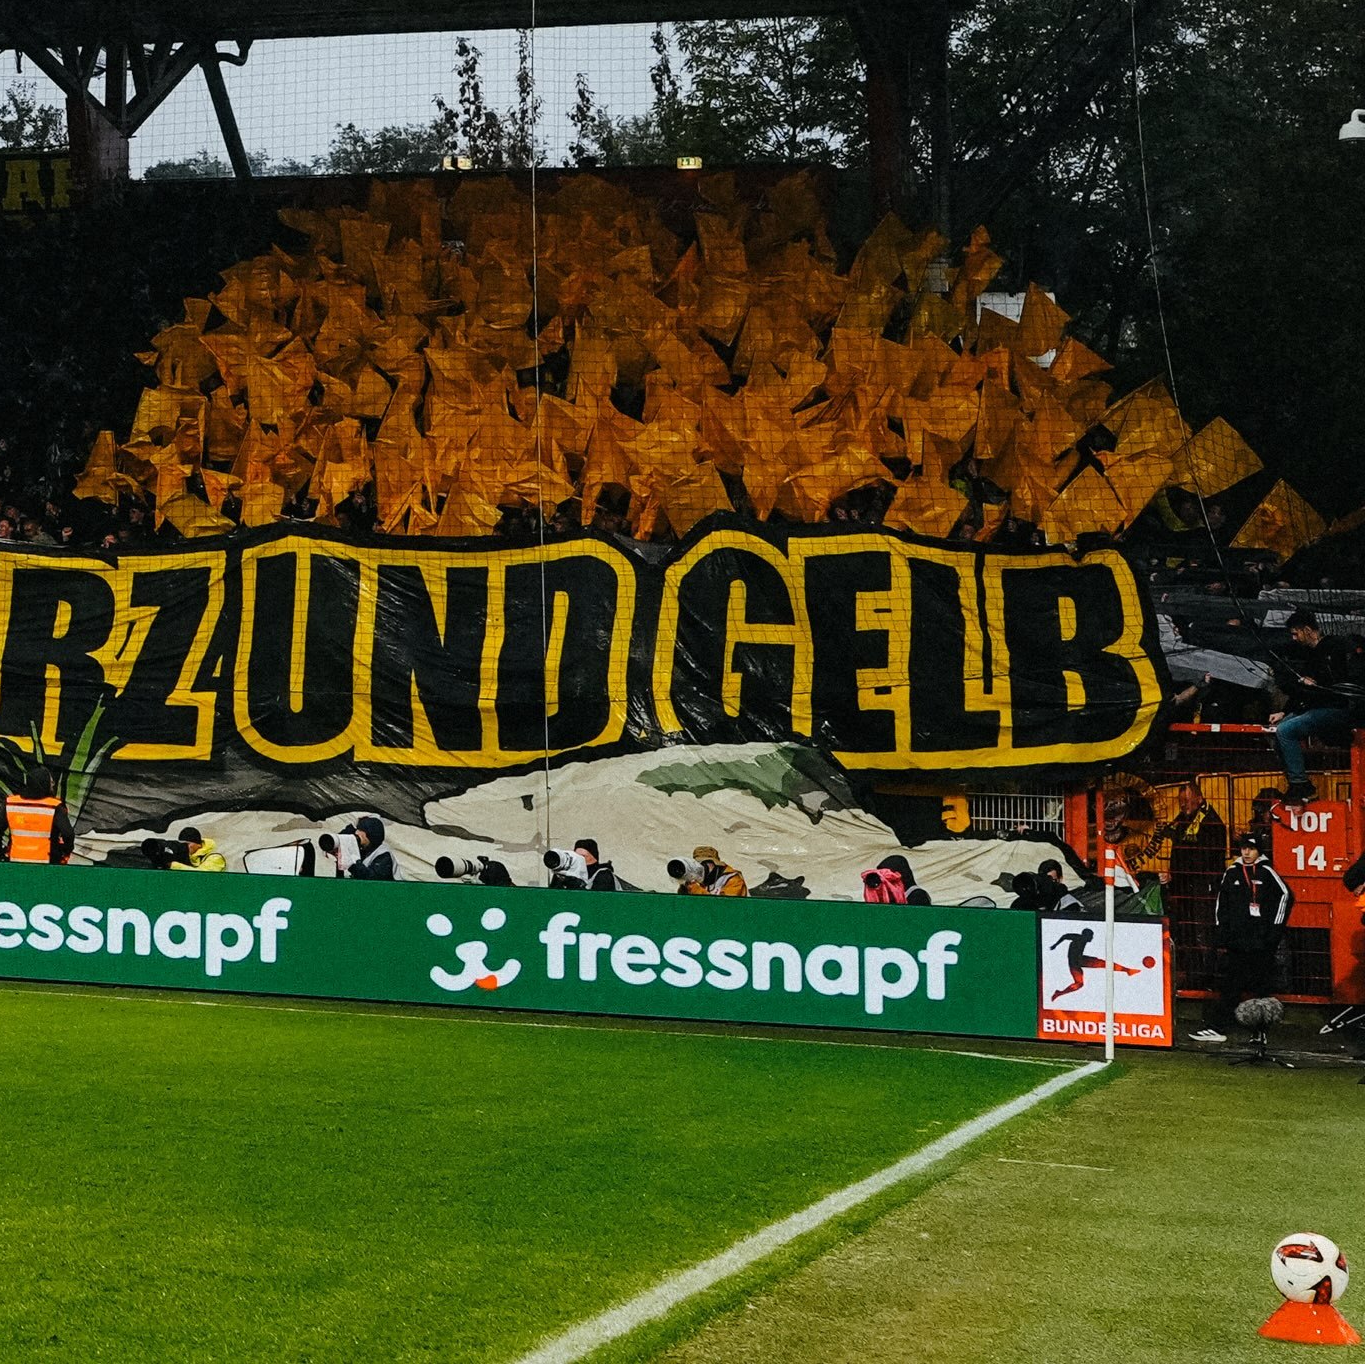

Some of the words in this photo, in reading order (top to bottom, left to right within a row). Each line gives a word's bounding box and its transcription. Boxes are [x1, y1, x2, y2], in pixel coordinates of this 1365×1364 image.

[235, 534, 635, 768] UND
[653, 530, 1164, 769] GELB
[1287, 804, 1333, 832] Tor
[1291, 844, 1327, 871] 14
[539, 912, 962, 1015] fressnapf
[1043, 1018, 1166, 1040] BUNDESLIGA
